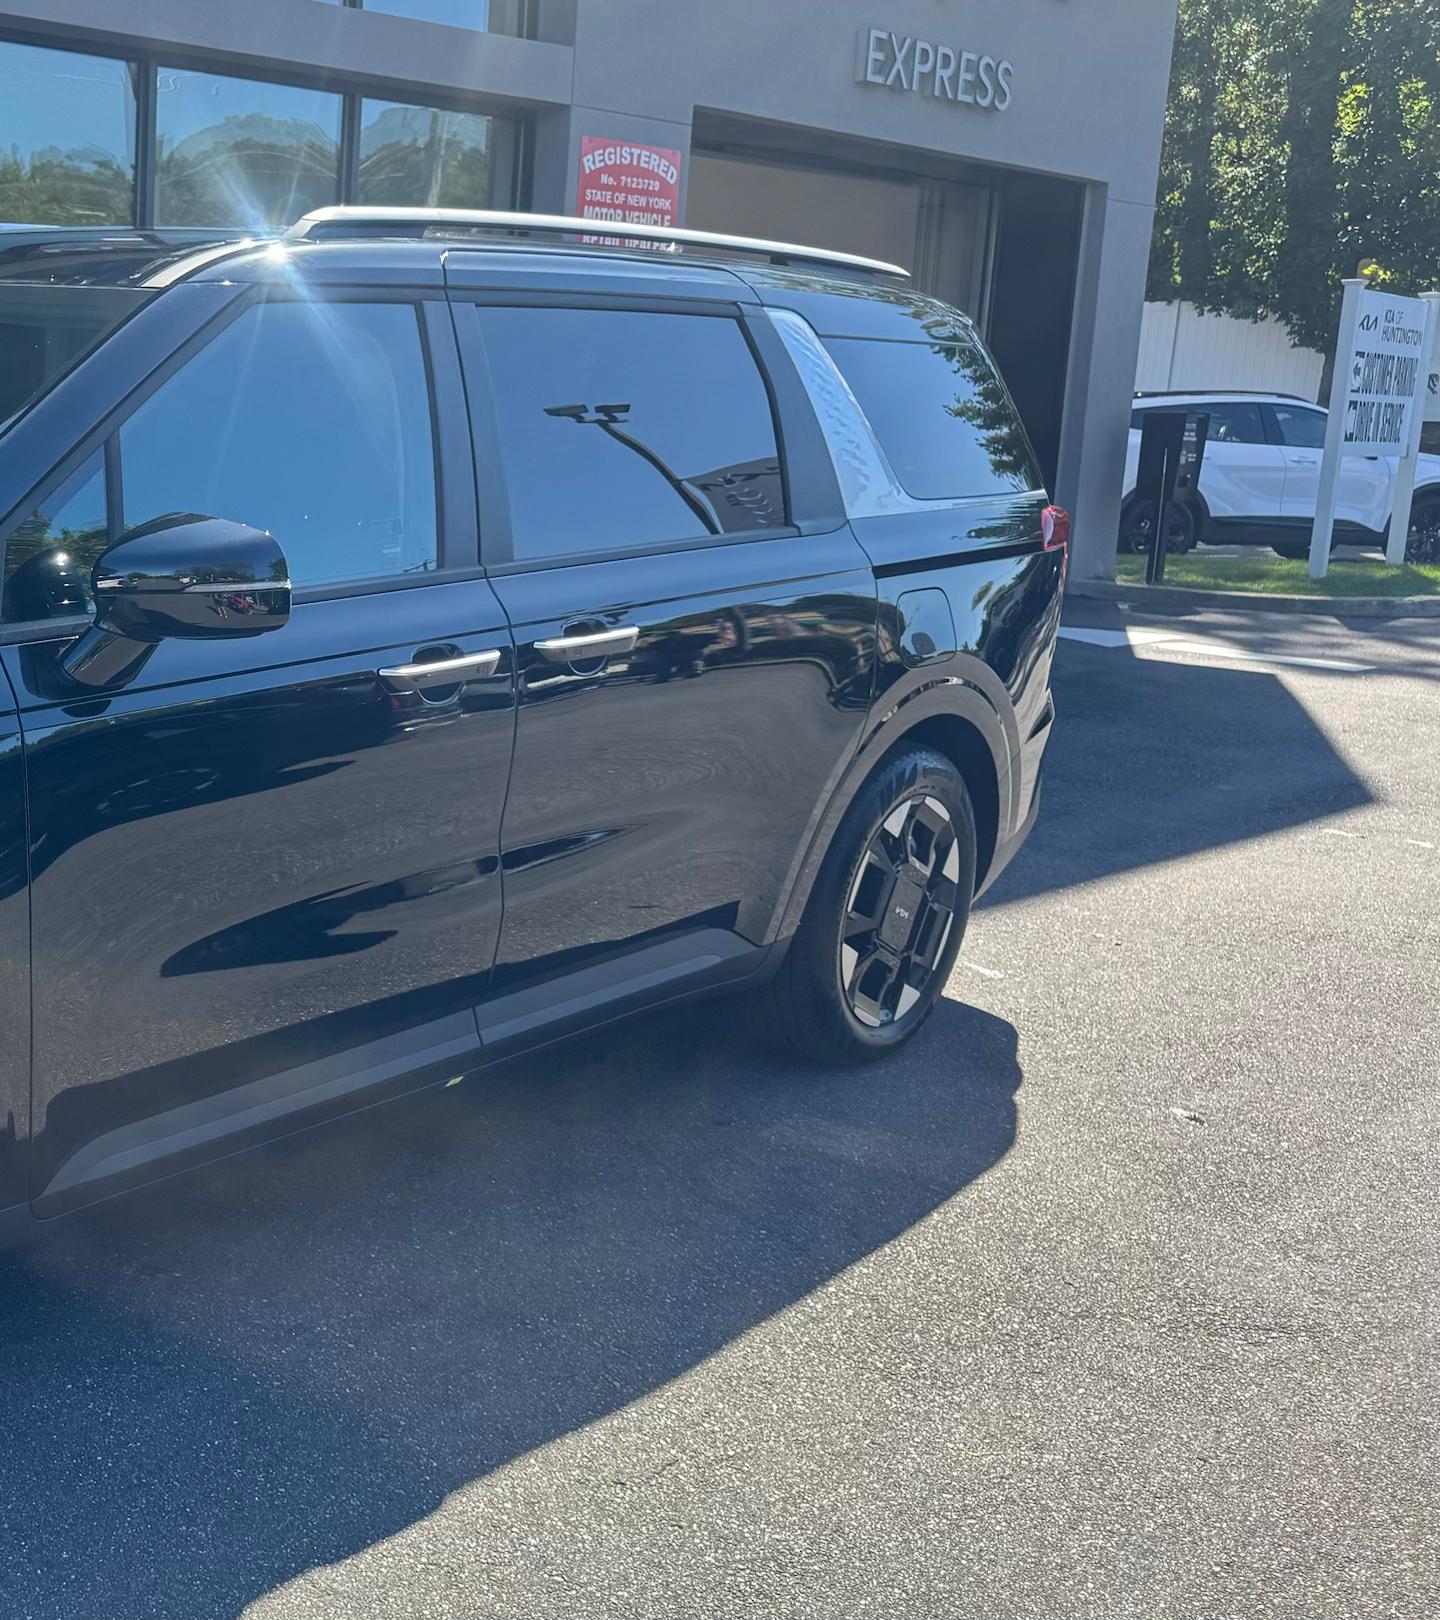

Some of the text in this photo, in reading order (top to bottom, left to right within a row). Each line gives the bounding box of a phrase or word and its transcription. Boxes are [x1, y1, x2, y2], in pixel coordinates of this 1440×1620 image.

[865, 28, 1014, 111] EXPRESS
[583, 147, 677, 184] REGISTERED
[600, 173, 617, 186] No.
[585, 189, 672, 210] STATE OF NEW YORK
[583, 206, 671, 226] MOTOR VEHICLE
[1381, 326, 1423, 346] HUNTINGTON
[1361, 352, 1395, 395] CUSTOMER
[1354, 400, 1405, 443] DRIVE IN SERVICE
